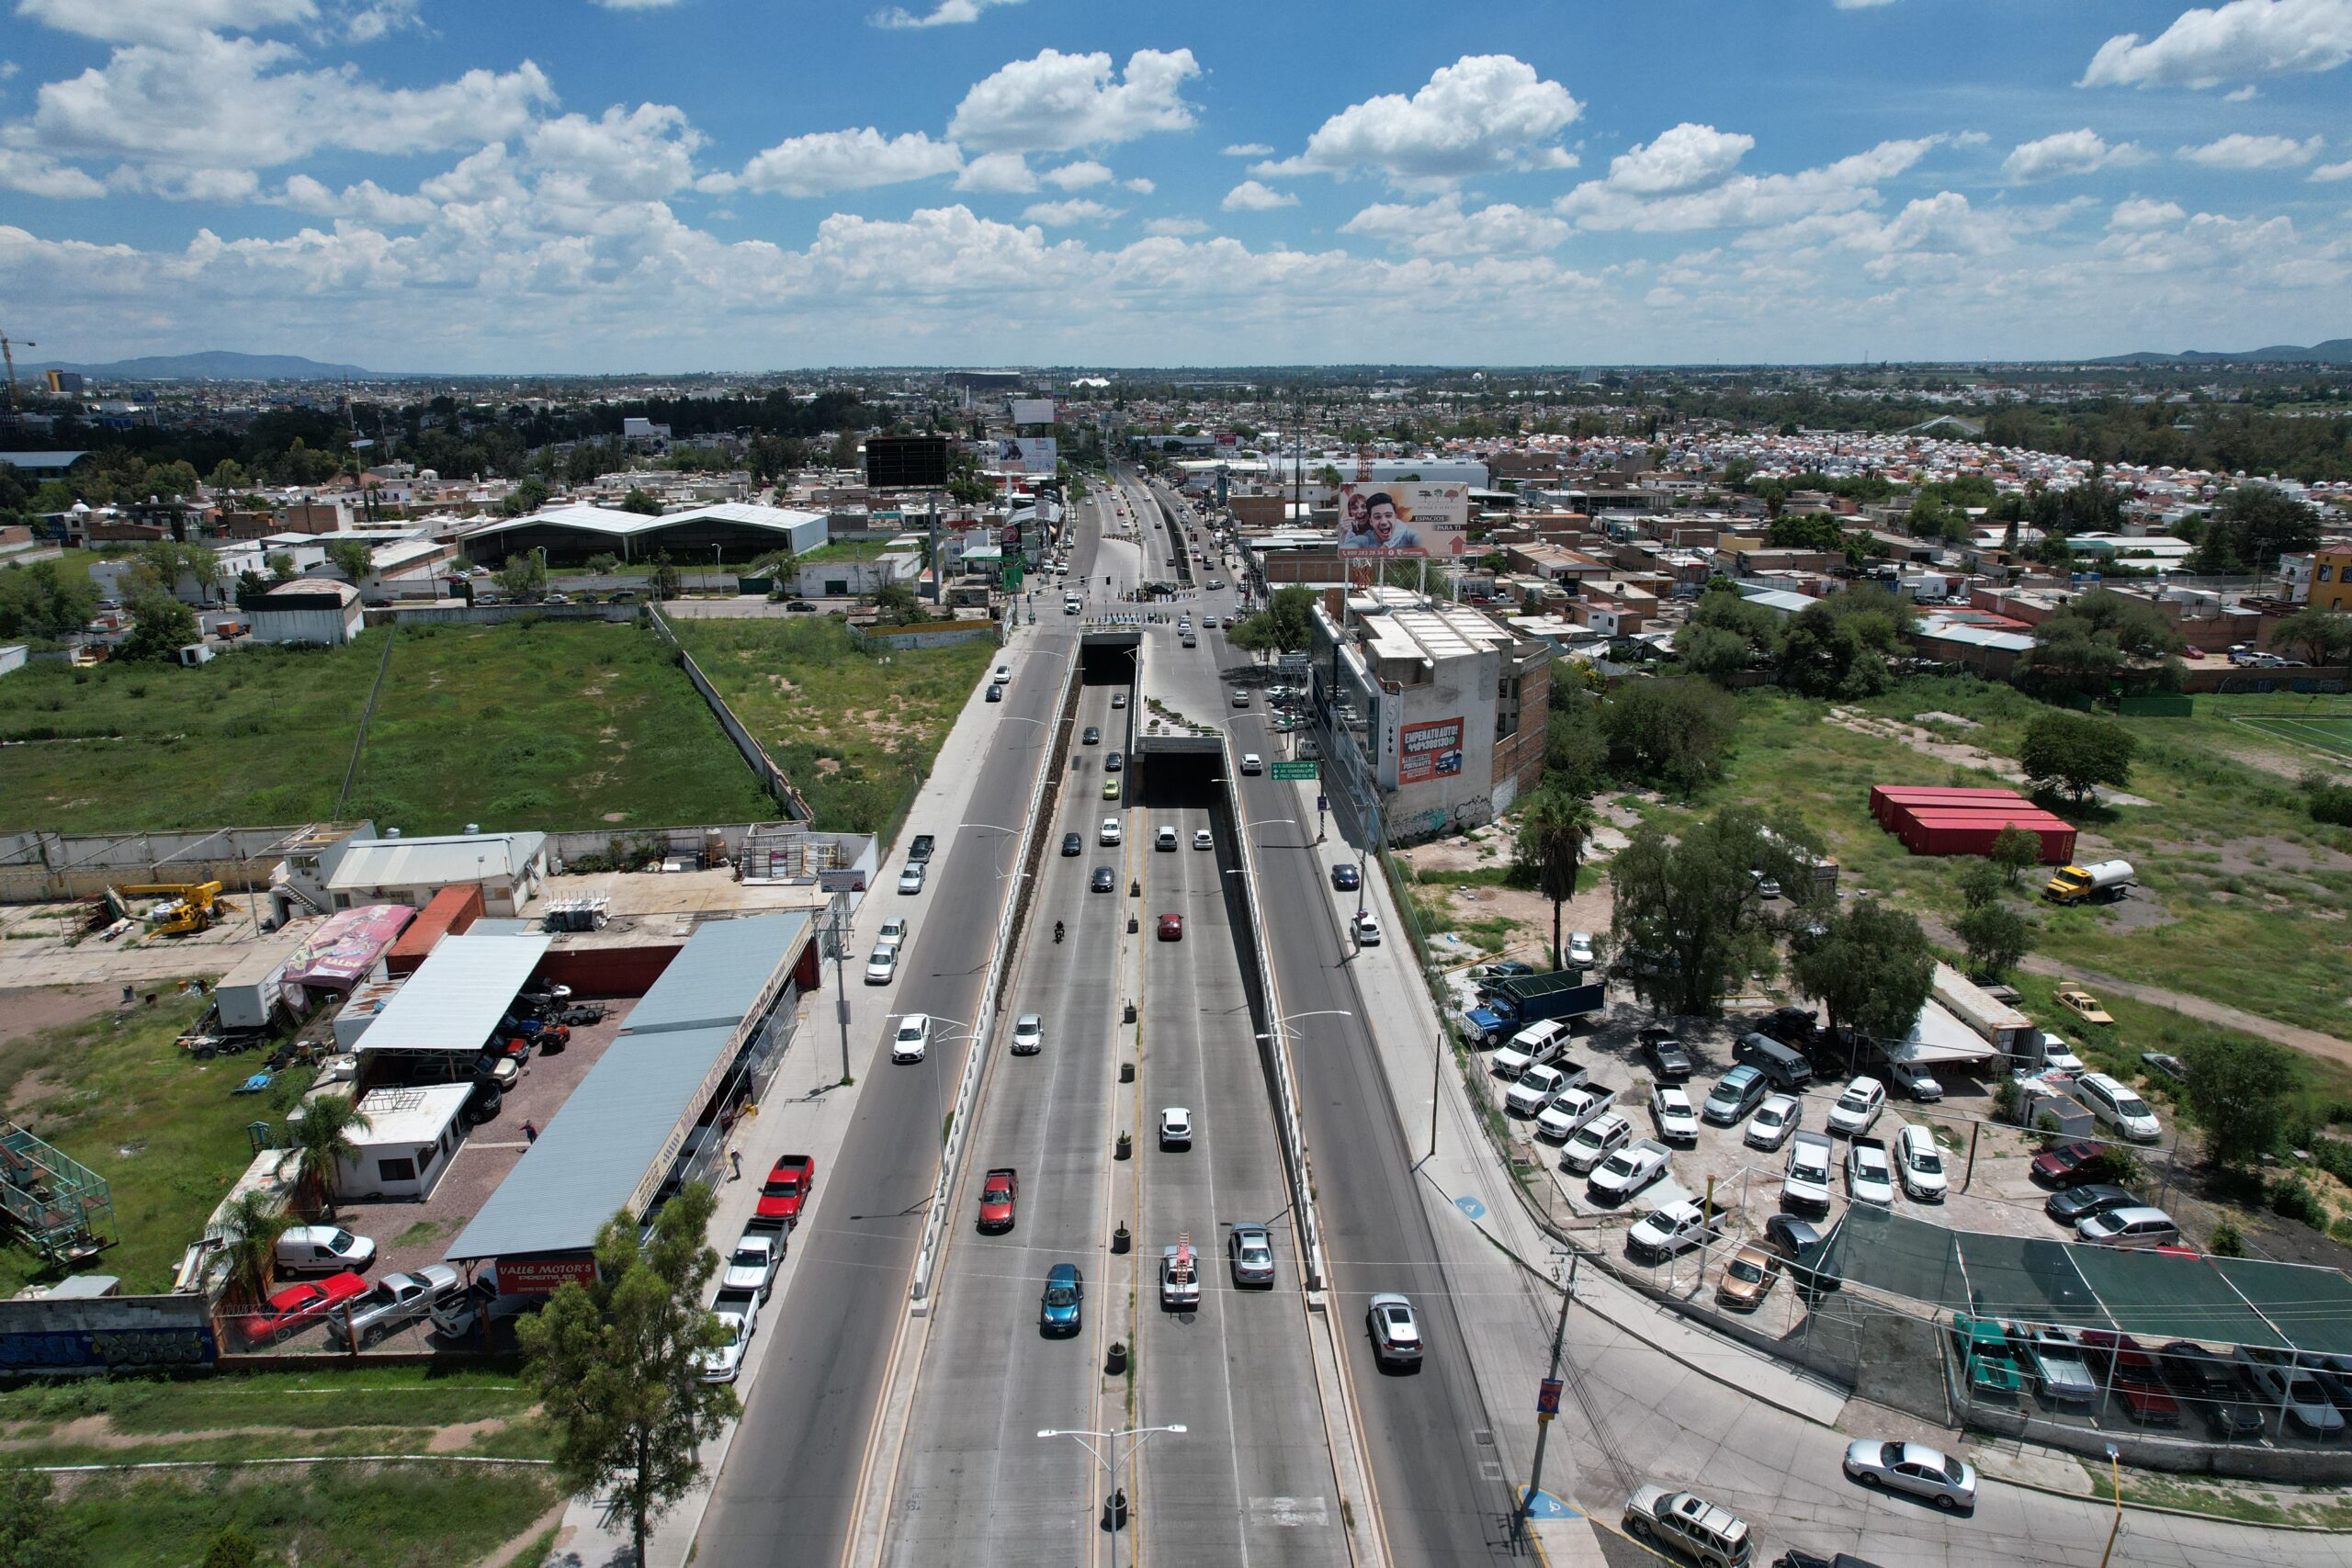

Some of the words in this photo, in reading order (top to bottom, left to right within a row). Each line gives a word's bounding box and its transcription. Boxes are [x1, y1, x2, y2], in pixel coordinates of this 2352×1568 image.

[1440, 725, 1458, 737] AUTO!
[680, 1089, 707, 1135] VALLE
[740, 977, 775, 1040] PREMIUM
[538, 1263, 592, 1274] MOTOR'S
